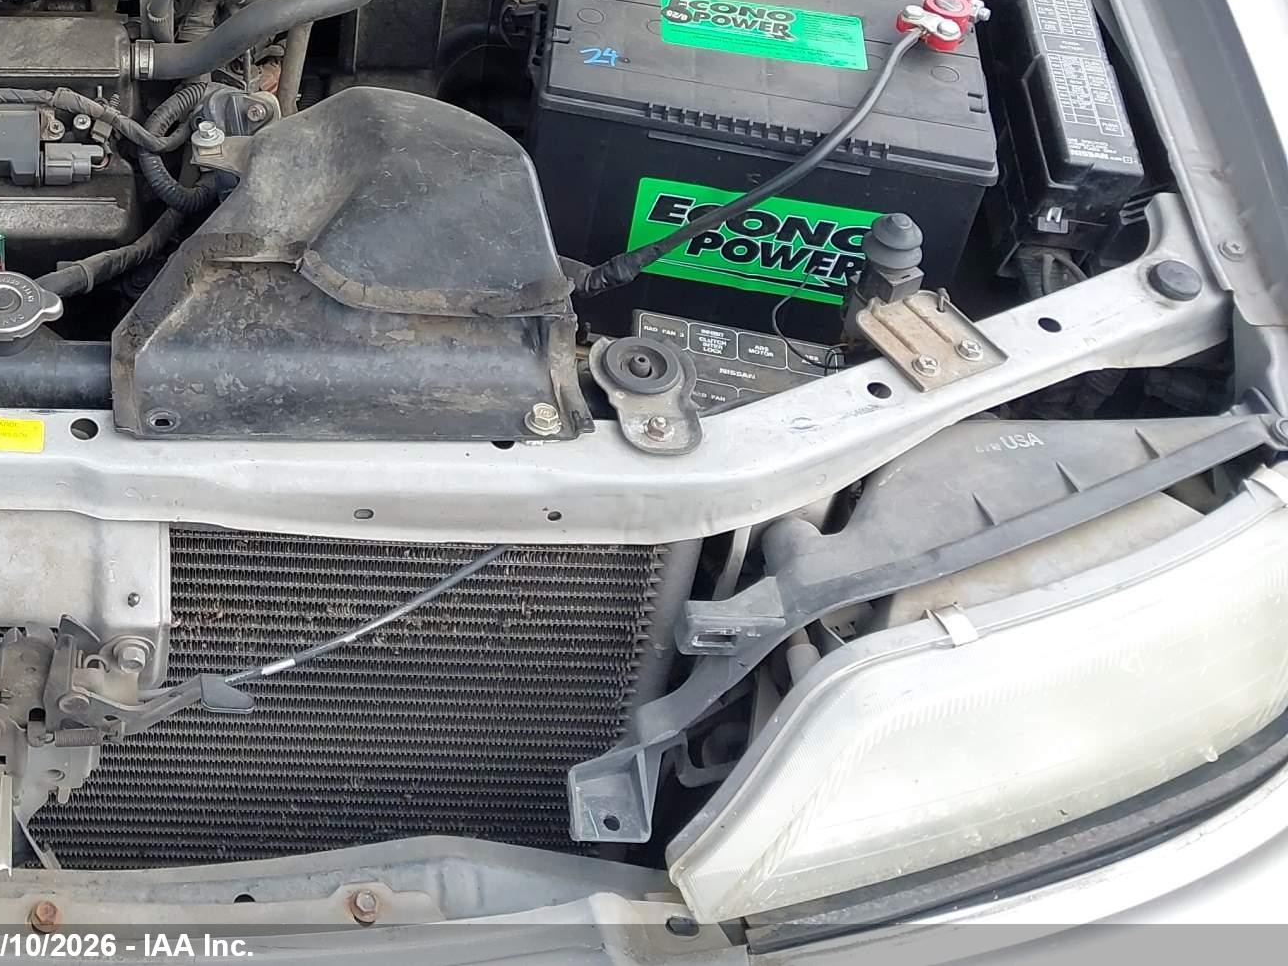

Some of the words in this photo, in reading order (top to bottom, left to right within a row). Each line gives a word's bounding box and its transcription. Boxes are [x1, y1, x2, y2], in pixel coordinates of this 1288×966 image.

[691, 10, 791, 36] POWER
[579, 47, 619, 66] 24
[684, 231, 863, 284] POWER
[698, 336, 727, 347] CLUTCH
[748, 348, 774, 357] MOTOR
[719, 367, 756, 380] NISSAN
[999, 432, 1045, 449] USA
